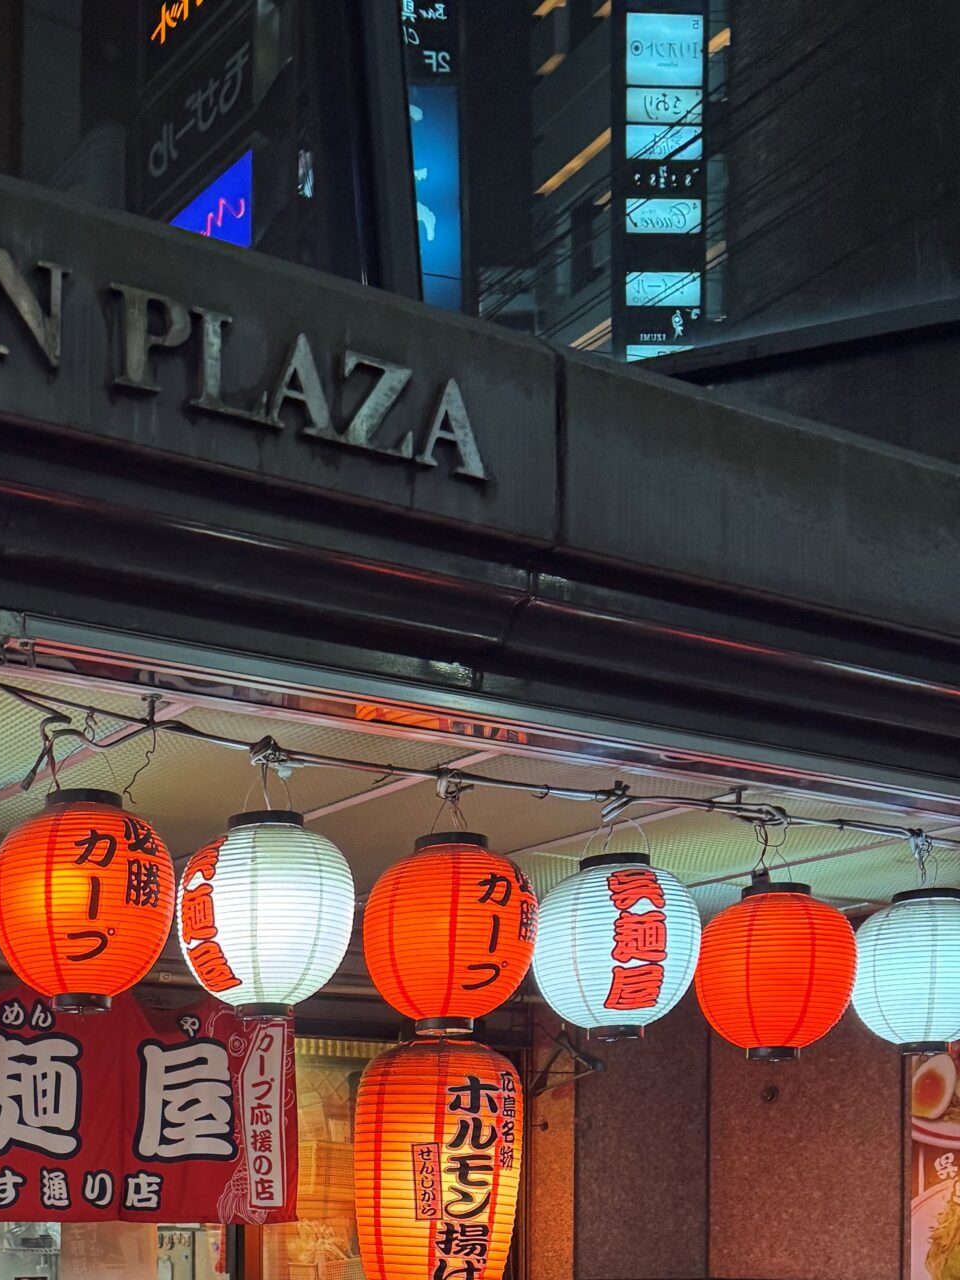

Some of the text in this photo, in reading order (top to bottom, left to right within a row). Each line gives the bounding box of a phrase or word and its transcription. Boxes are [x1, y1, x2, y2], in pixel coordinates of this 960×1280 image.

[110, 282, 492, 483] PLAZA
[66, 829, 118, 962] カープ
[123, 817, 161, 908] 必勝
[460, 872, 514, 991] カープ
[603, 868, 668, 1010] 呉麺屋
[0, 1001, 54, 1034] めん
[250, 1032, 275, 1201] カープ応援の店
